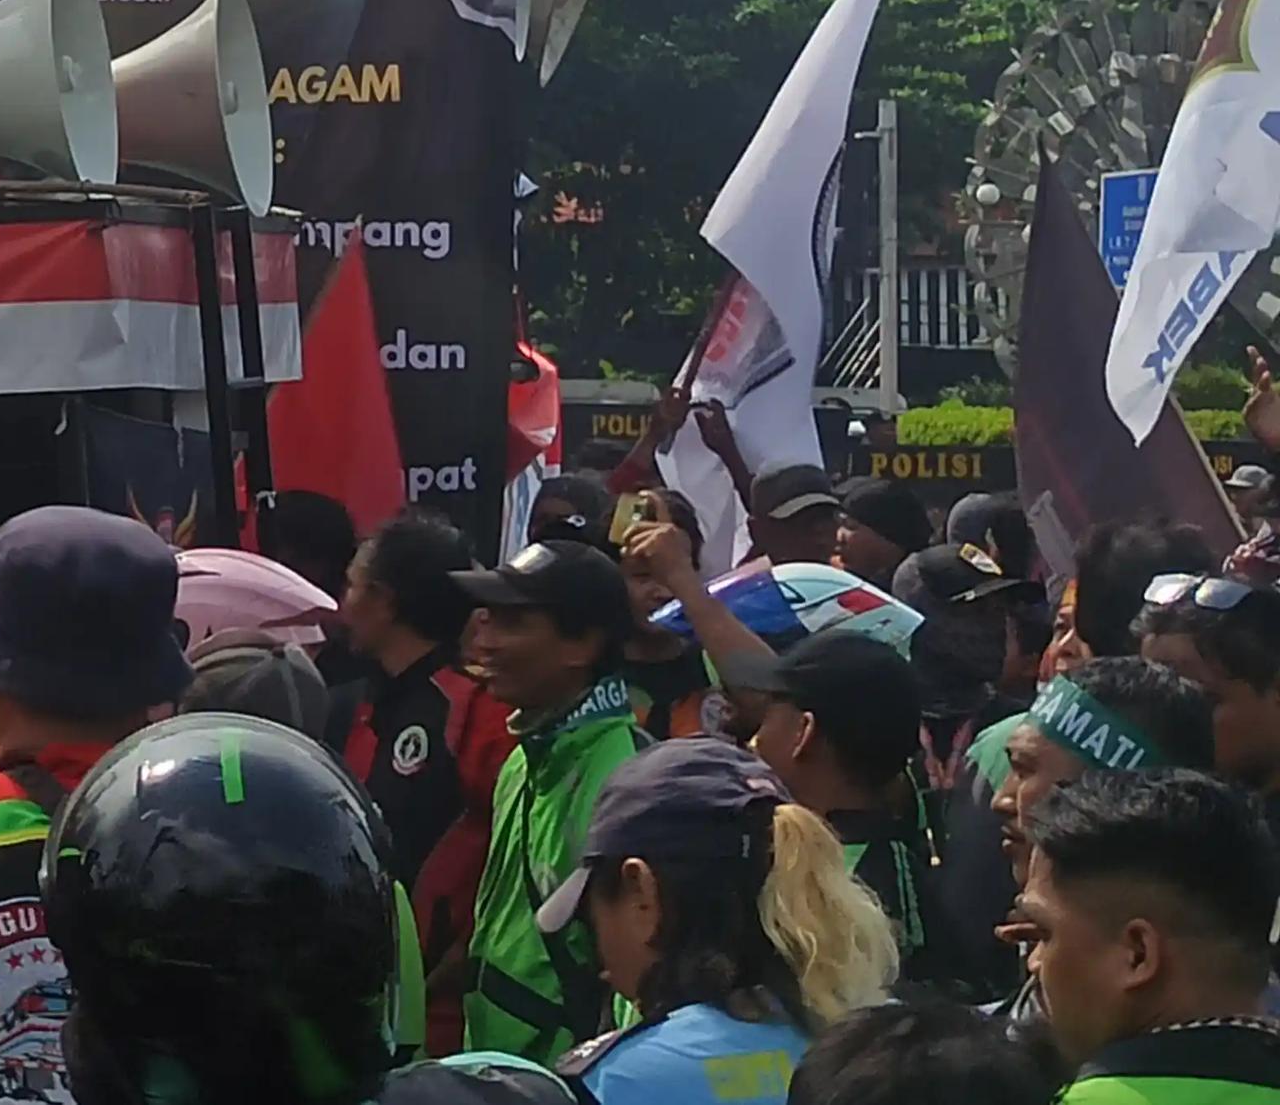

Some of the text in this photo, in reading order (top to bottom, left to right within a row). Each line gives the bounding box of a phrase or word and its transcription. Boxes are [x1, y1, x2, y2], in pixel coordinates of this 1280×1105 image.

[268, 63, 401, 104] AGAM
[379, 328, 466, 370] dan
[400, 457, 477, 503] pat
[871, 452, 982, 479] POLISI
[1056, 702, 1145, 771] MATI
